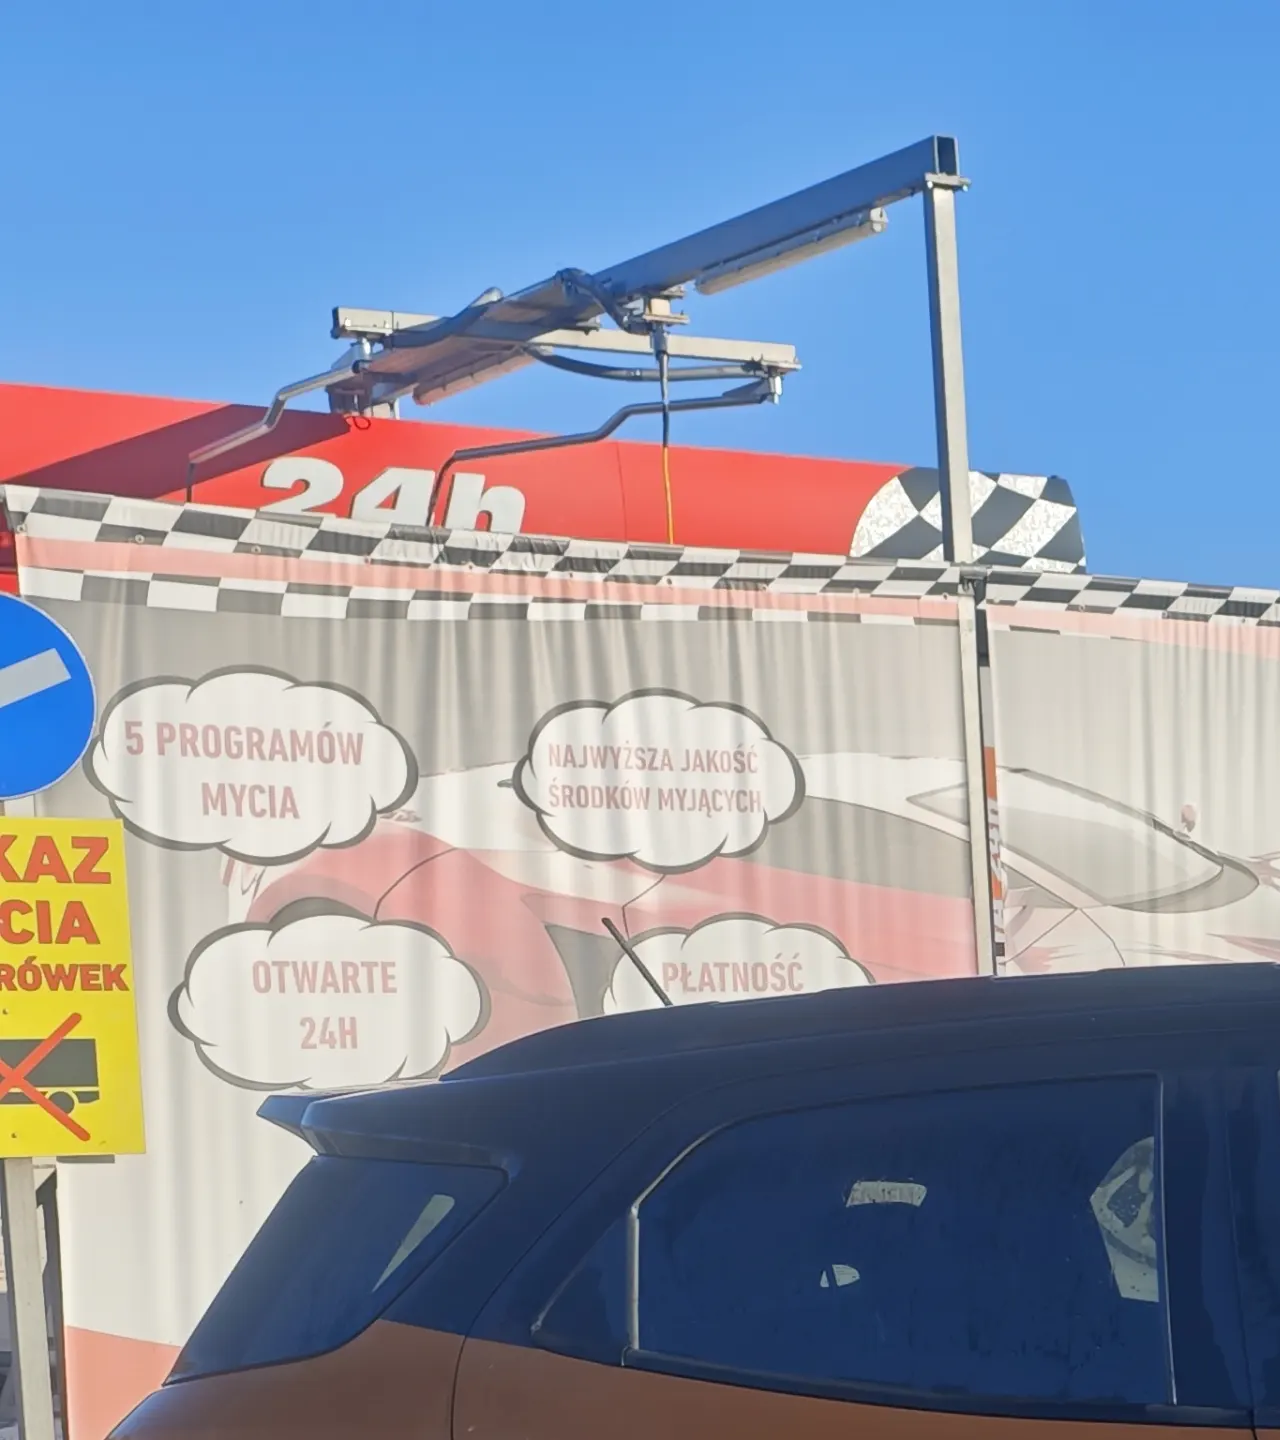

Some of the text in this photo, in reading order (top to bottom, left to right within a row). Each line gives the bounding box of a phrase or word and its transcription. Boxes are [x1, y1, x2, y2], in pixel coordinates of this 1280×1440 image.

[260, 456, 526, 533] 24h
[125, 720, 364, 765] 5 PROGRAMÓW
[548, 740, 758, 774] NAJWYŻSZA JAKOŚĆ
[201, 782, 300, 820] MYCIA
[548, 777, 762, 818] ŚRODKÓW MYJĄCYCH
[252, 960, 398, 994] OTWARTE
[661, 952, 804, 993] PŁATNOŚĆ
[300, 1016, 358, 1050] 24H
